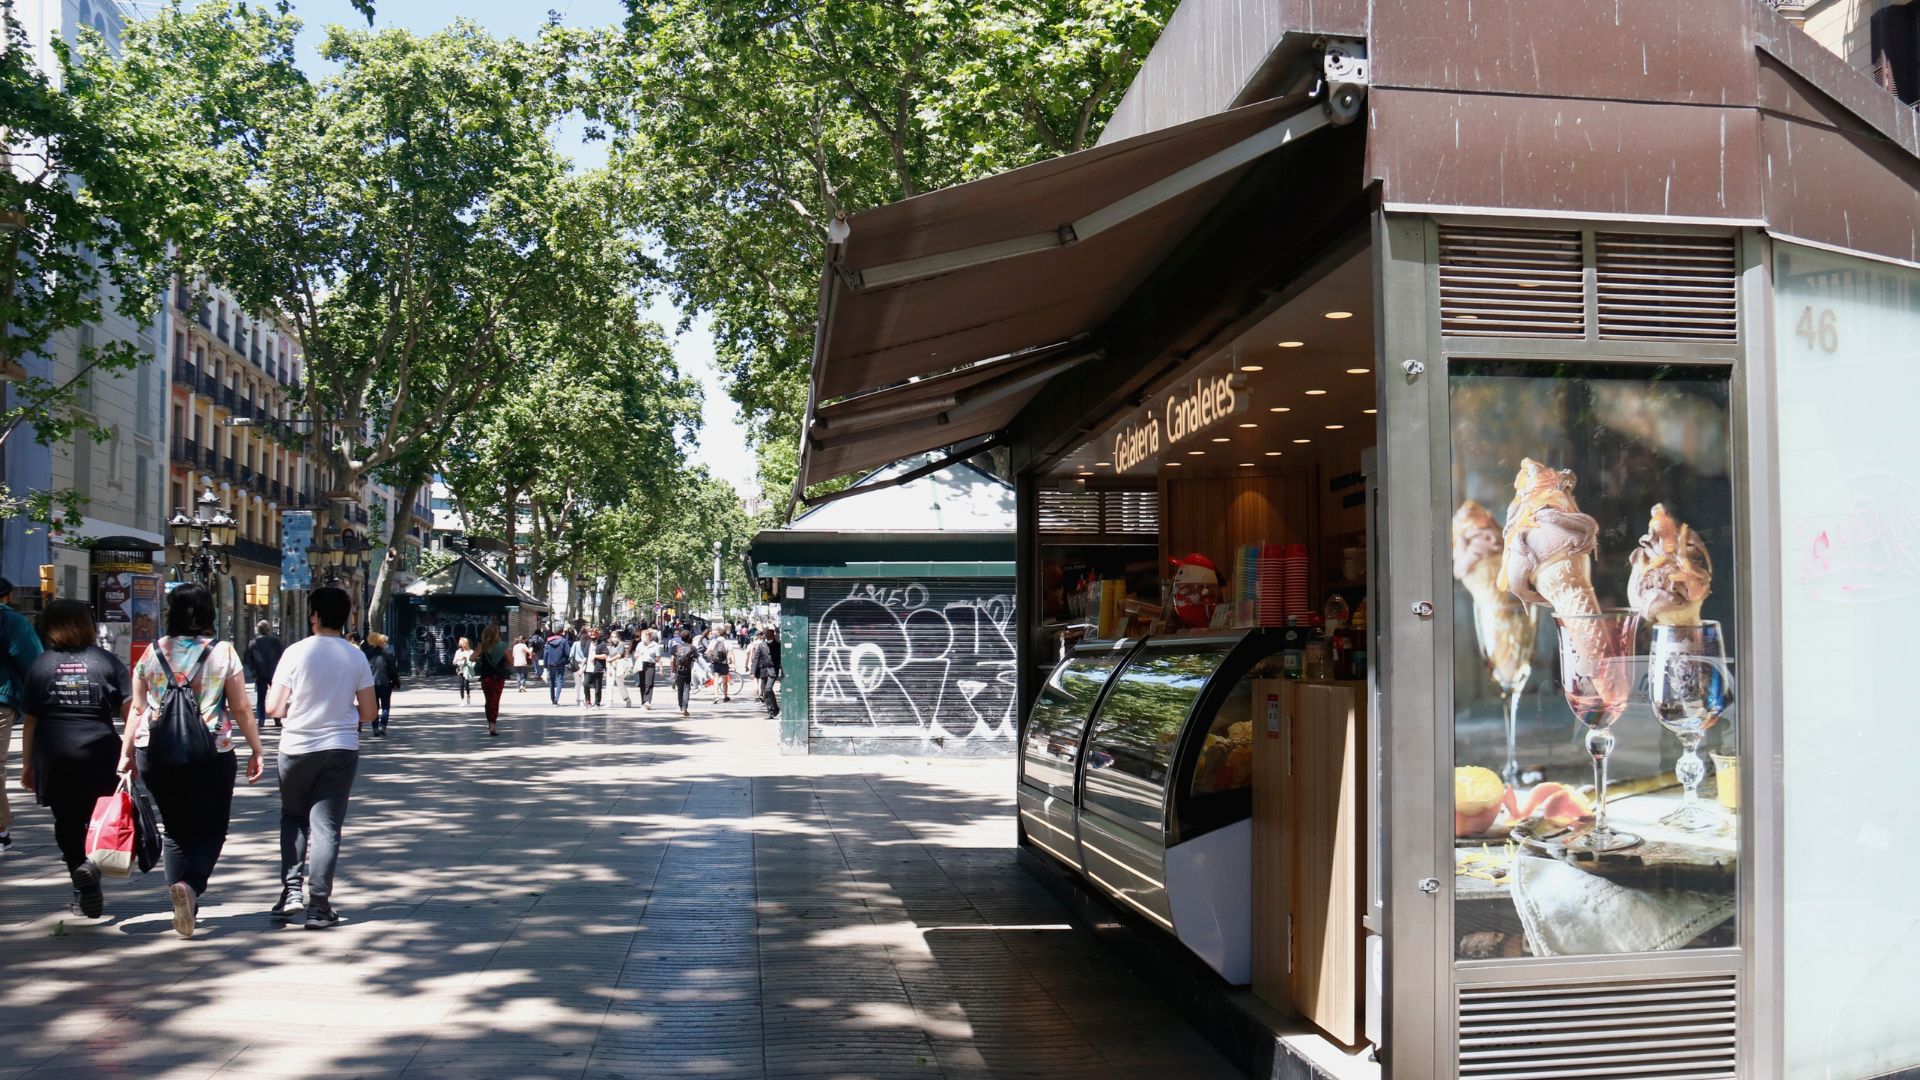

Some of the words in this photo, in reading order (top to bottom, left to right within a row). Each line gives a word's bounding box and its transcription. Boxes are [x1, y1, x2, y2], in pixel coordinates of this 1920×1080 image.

[1795, 306, 1839, 354] 46
[1114, 410, 1159, 474] Gelateria
[1166, 373, 1235, 443] Canaletes
